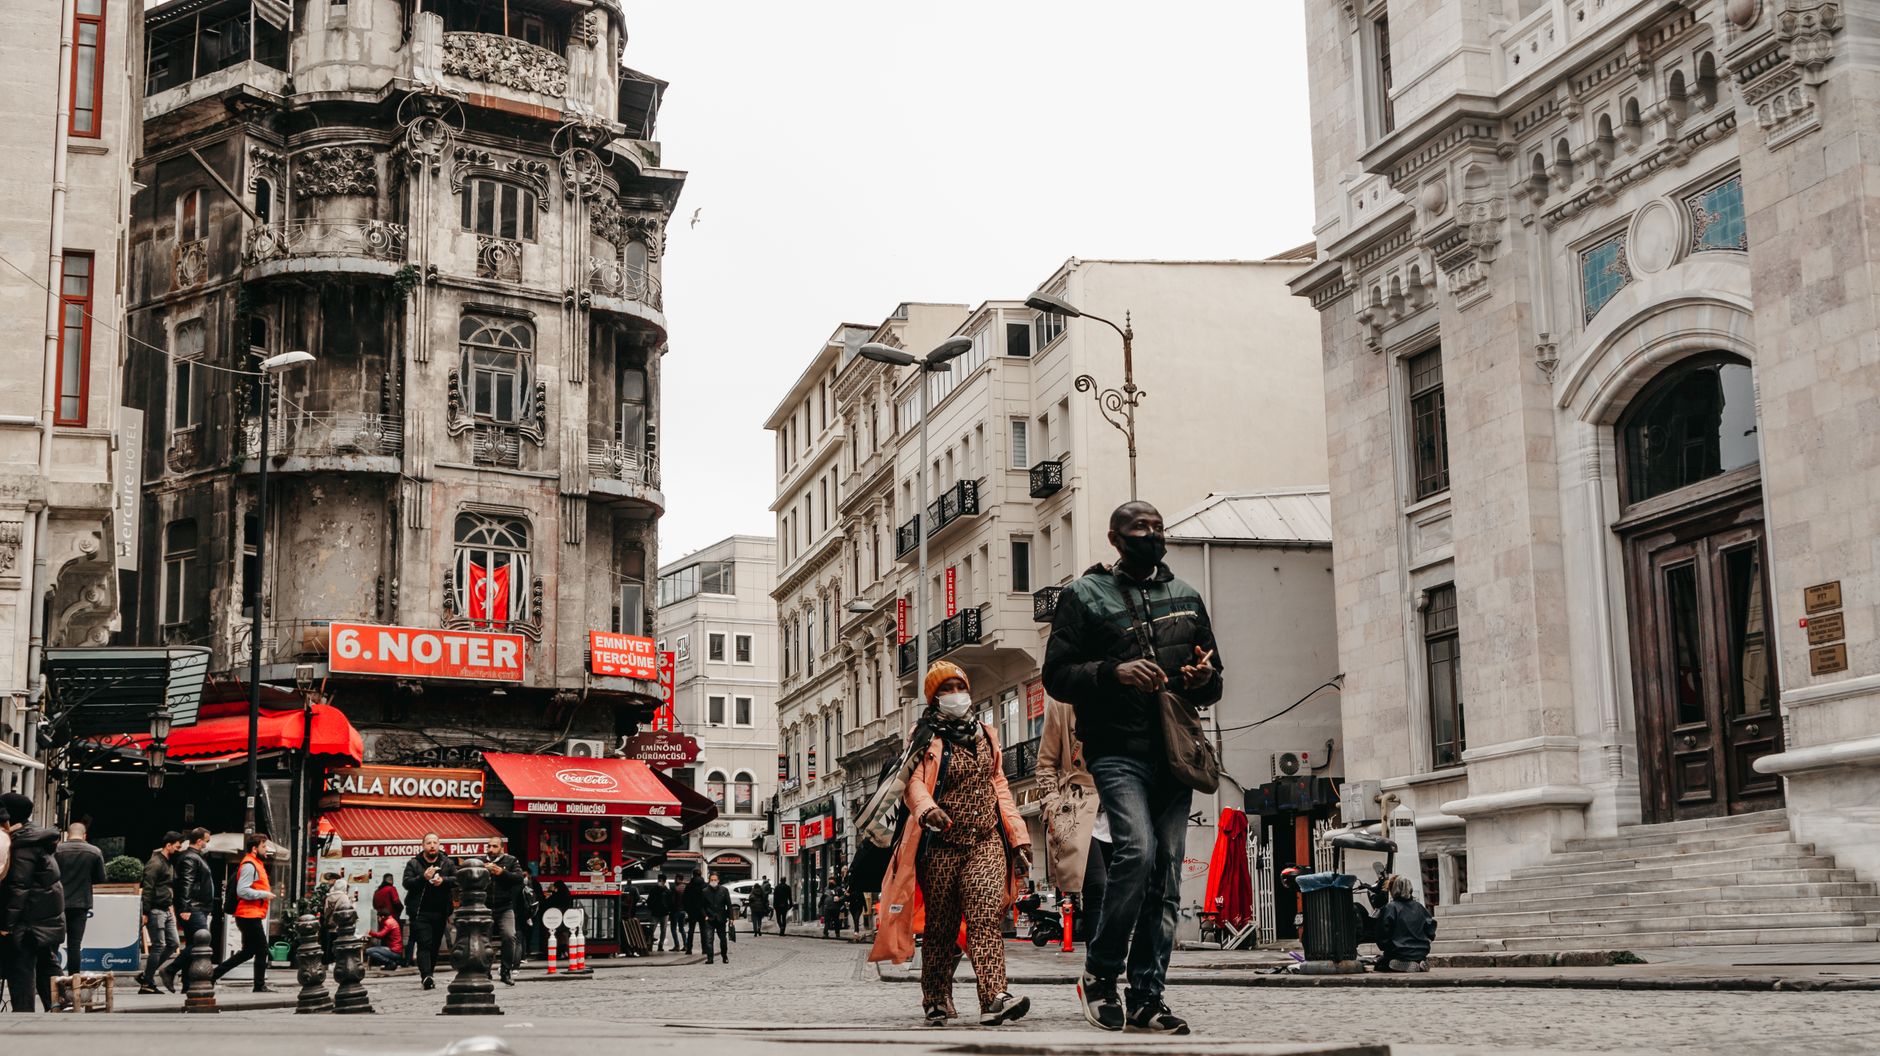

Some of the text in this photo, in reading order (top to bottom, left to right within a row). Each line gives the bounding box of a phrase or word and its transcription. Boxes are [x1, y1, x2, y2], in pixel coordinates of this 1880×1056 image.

[126, 422, 137, 470] HOTEL
[336, 629, 518, 668] 6. NOTER
[595, 635, 651, 653] EMNİYET
[594, 650, 655, 669] TERCÜME
[636, 752, 686, 760] DÜRÜMCÜSÜ
[640, 743, 682, 752] EMİNÖNÜ
[389, 776, 483, 804] KOKOREÇ
[527, 801, 607, 814] EMİNÖNÜ DÜRÜMCÜSÜ
[351, 846, 379, 856] GALA
[450, 843, 479, 854] PİLAV
